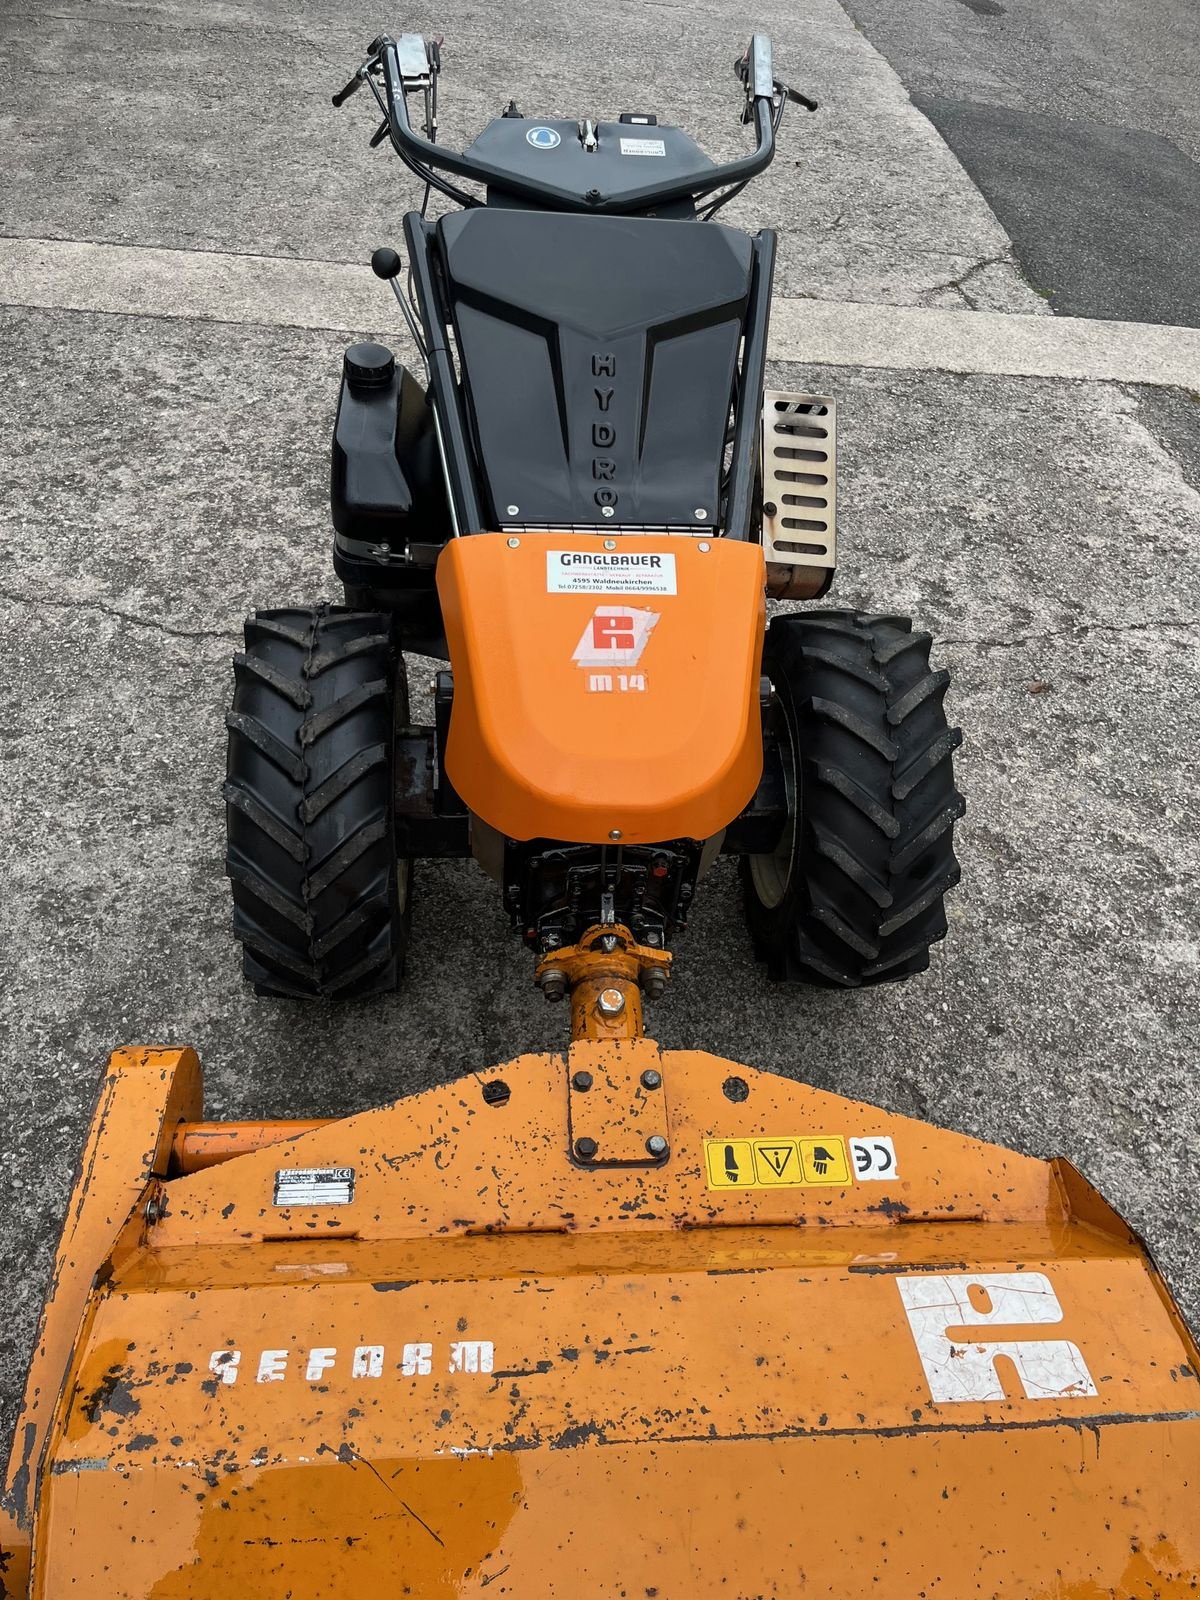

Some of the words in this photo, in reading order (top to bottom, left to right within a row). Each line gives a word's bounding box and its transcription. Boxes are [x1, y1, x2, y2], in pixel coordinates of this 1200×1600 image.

[591, 351, 618, 508] HYDRO
[560, 553, 661, 568] GANGLBAUER
[617, 674, 645, 691] 14
[208, 1340, 495, 1384] REFORM
